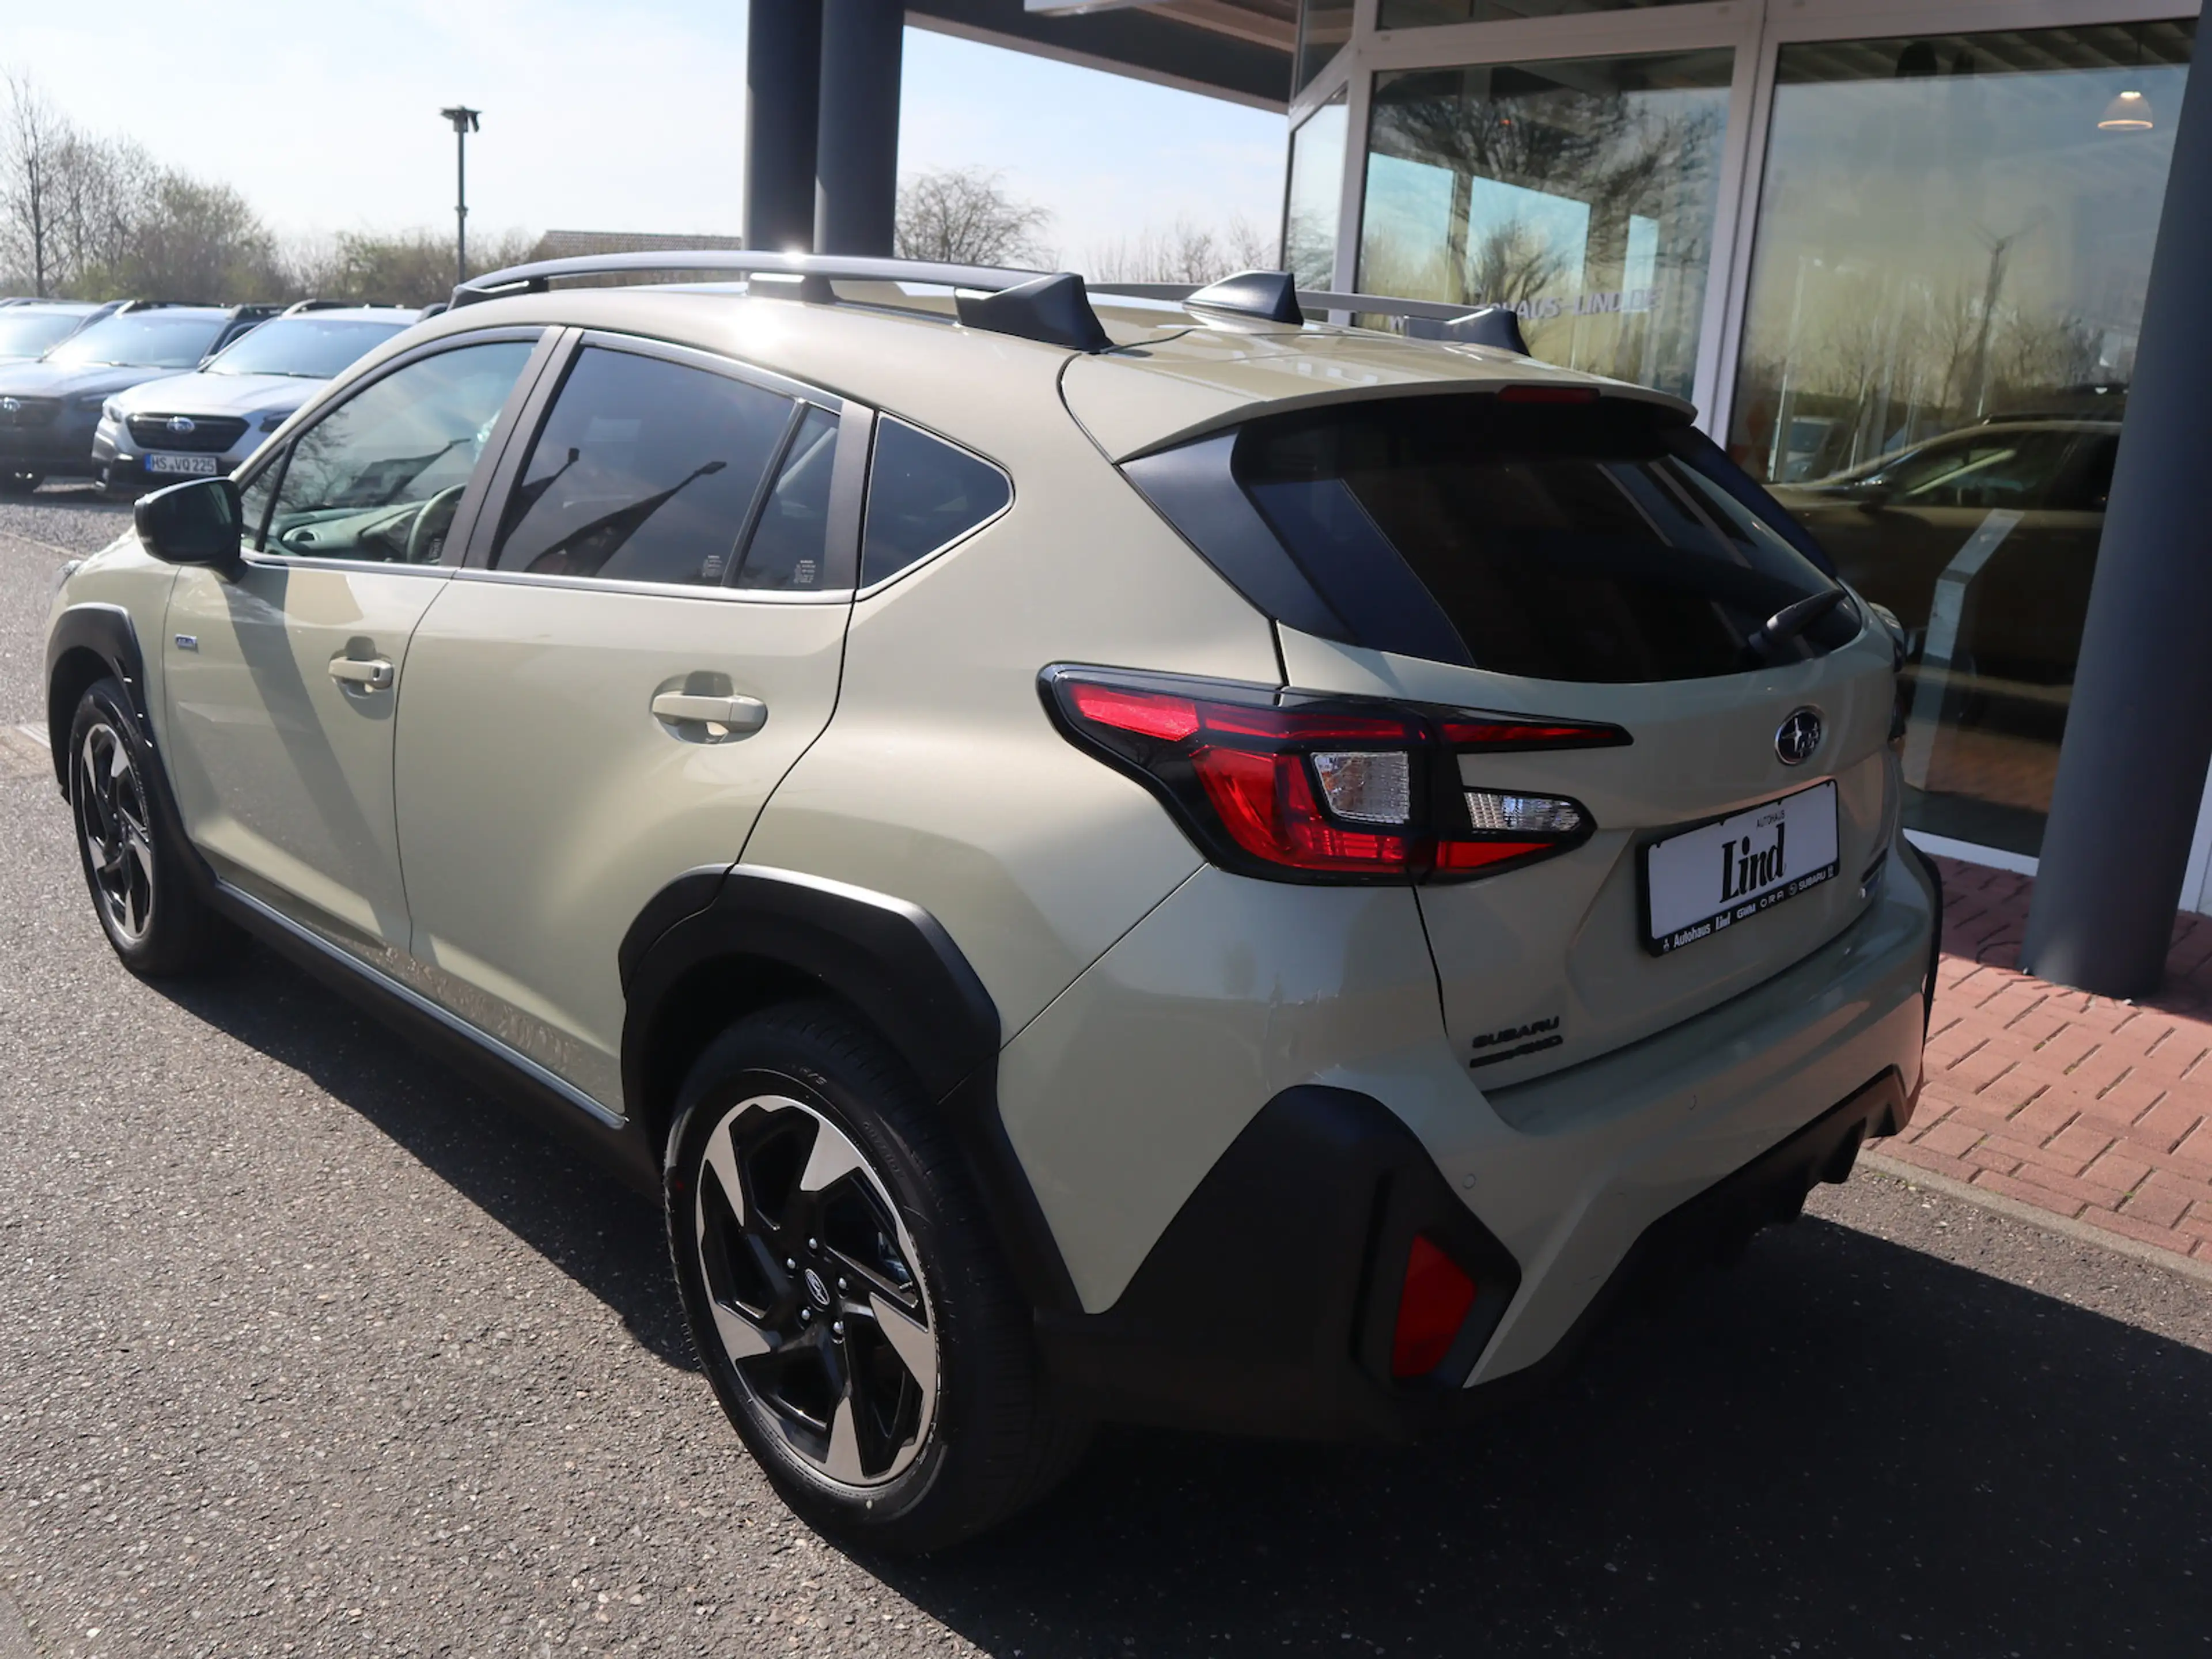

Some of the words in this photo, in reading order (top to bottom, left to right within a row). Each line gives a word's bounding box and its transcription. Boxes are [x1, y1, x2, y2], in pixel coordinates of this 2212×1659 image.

[151, 456, 167, 470] HS
[193, 459, 215, 472] 225
[1756, 809, 1785, 830] AUTOHAUS
[1719, 822, 1786, 903] Lind
[1673, 923, 1711, 947] Autohaus
[1715, 911, 1731, 930] Lind
[1760, 891, 1785, 908] ORA
[1798, 870, 1827, 891] SUBARU
[1472, 1016, 1559, 1048] SUBARU
